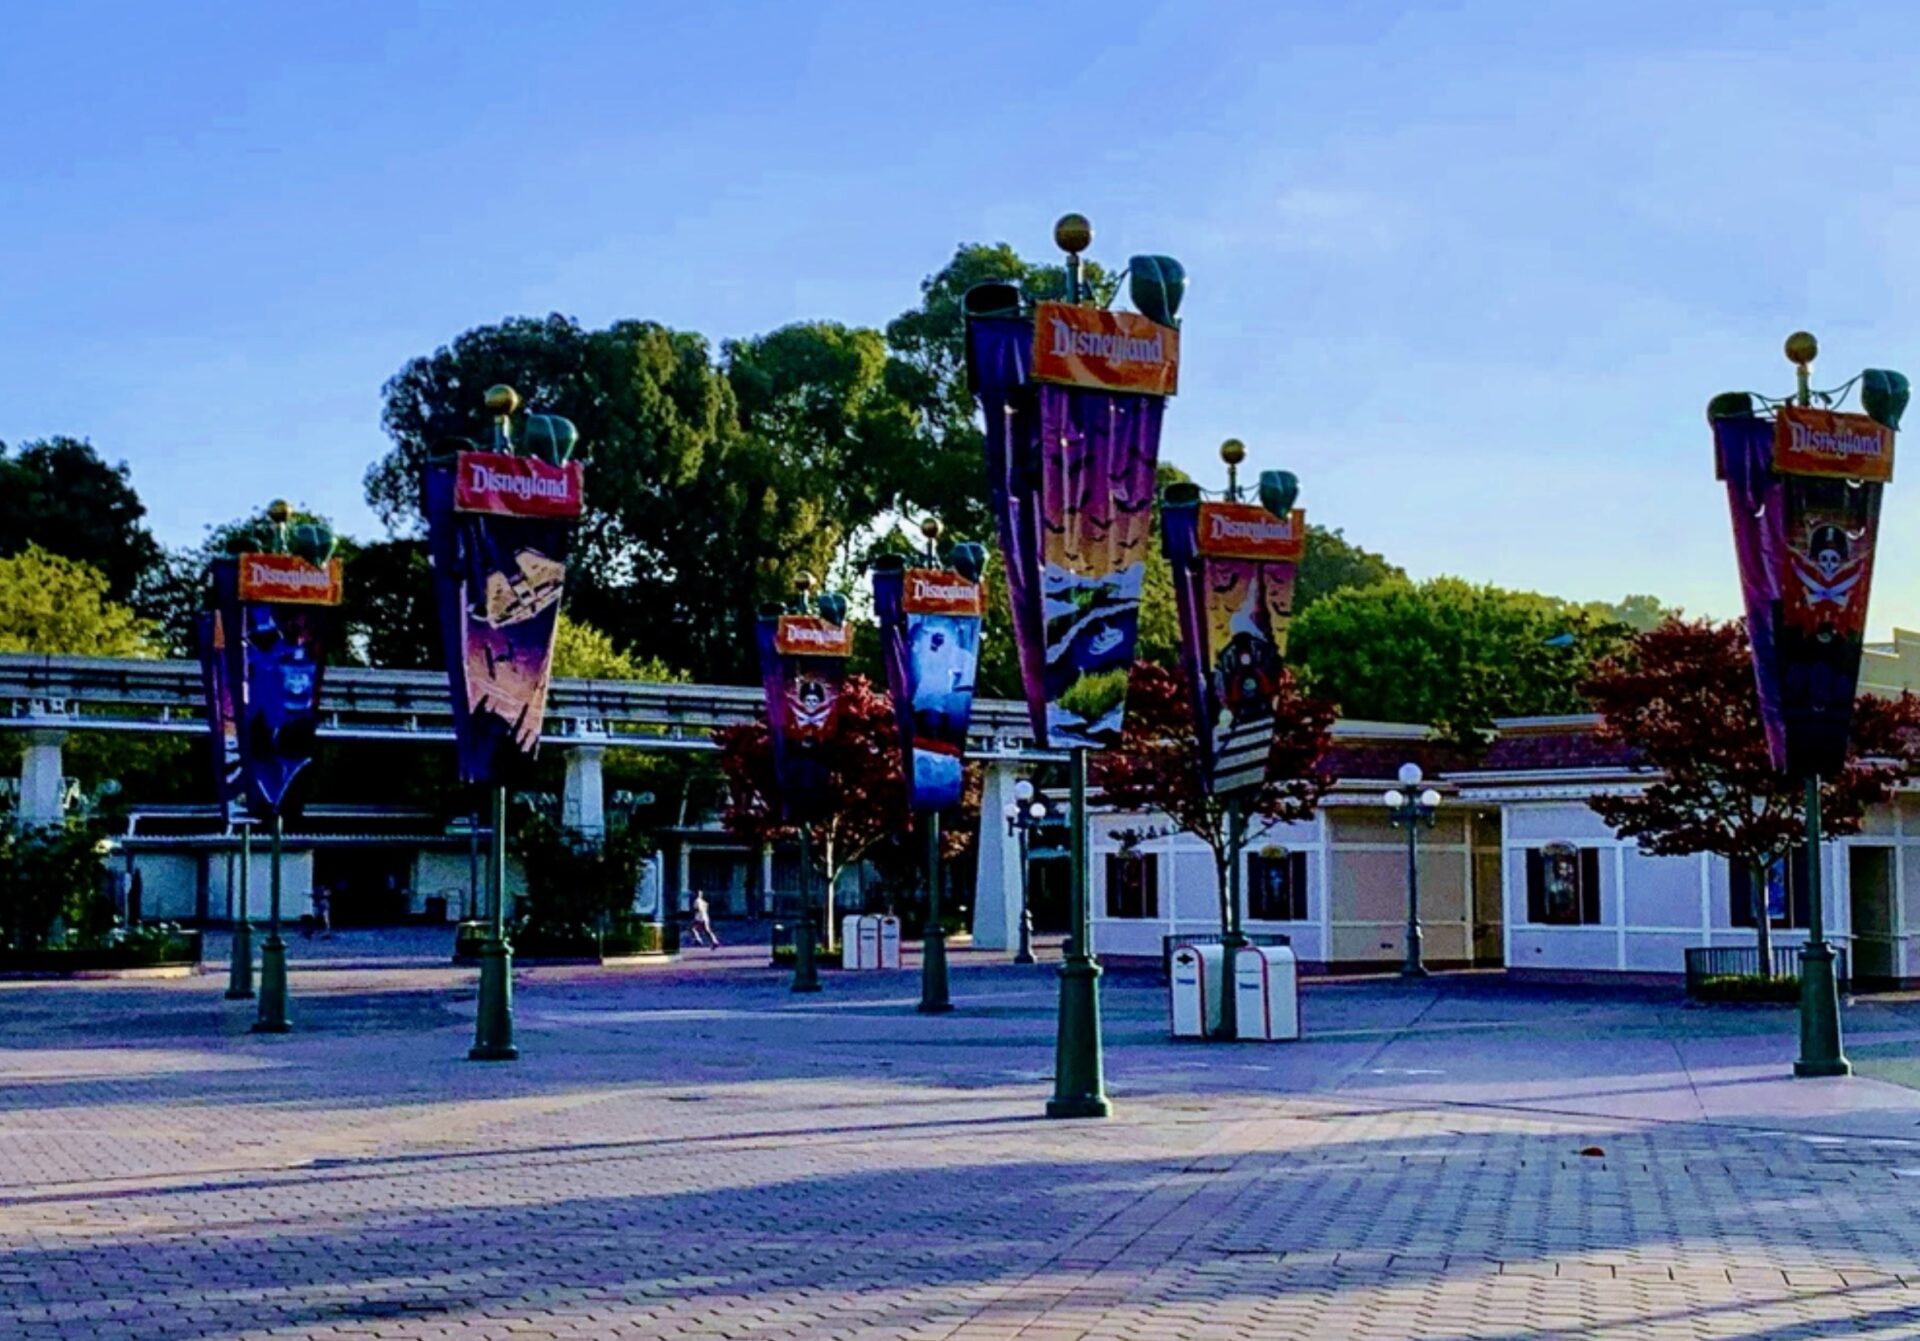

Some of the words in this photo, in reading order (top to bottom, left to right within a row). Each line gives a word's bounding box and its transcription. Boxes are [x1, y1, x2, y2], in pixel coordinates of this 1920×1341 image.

[1050, 318, 1162, 363] Disneyland
[1789, 421, 1882, 458] Disneyland
[470, 463, 568, 498] Disneyland
[1210, 514, 1292, 541] Disneyland
[250, 562, 329, 588] Disneyland
[914, 580, 977, 599] Disneyland
